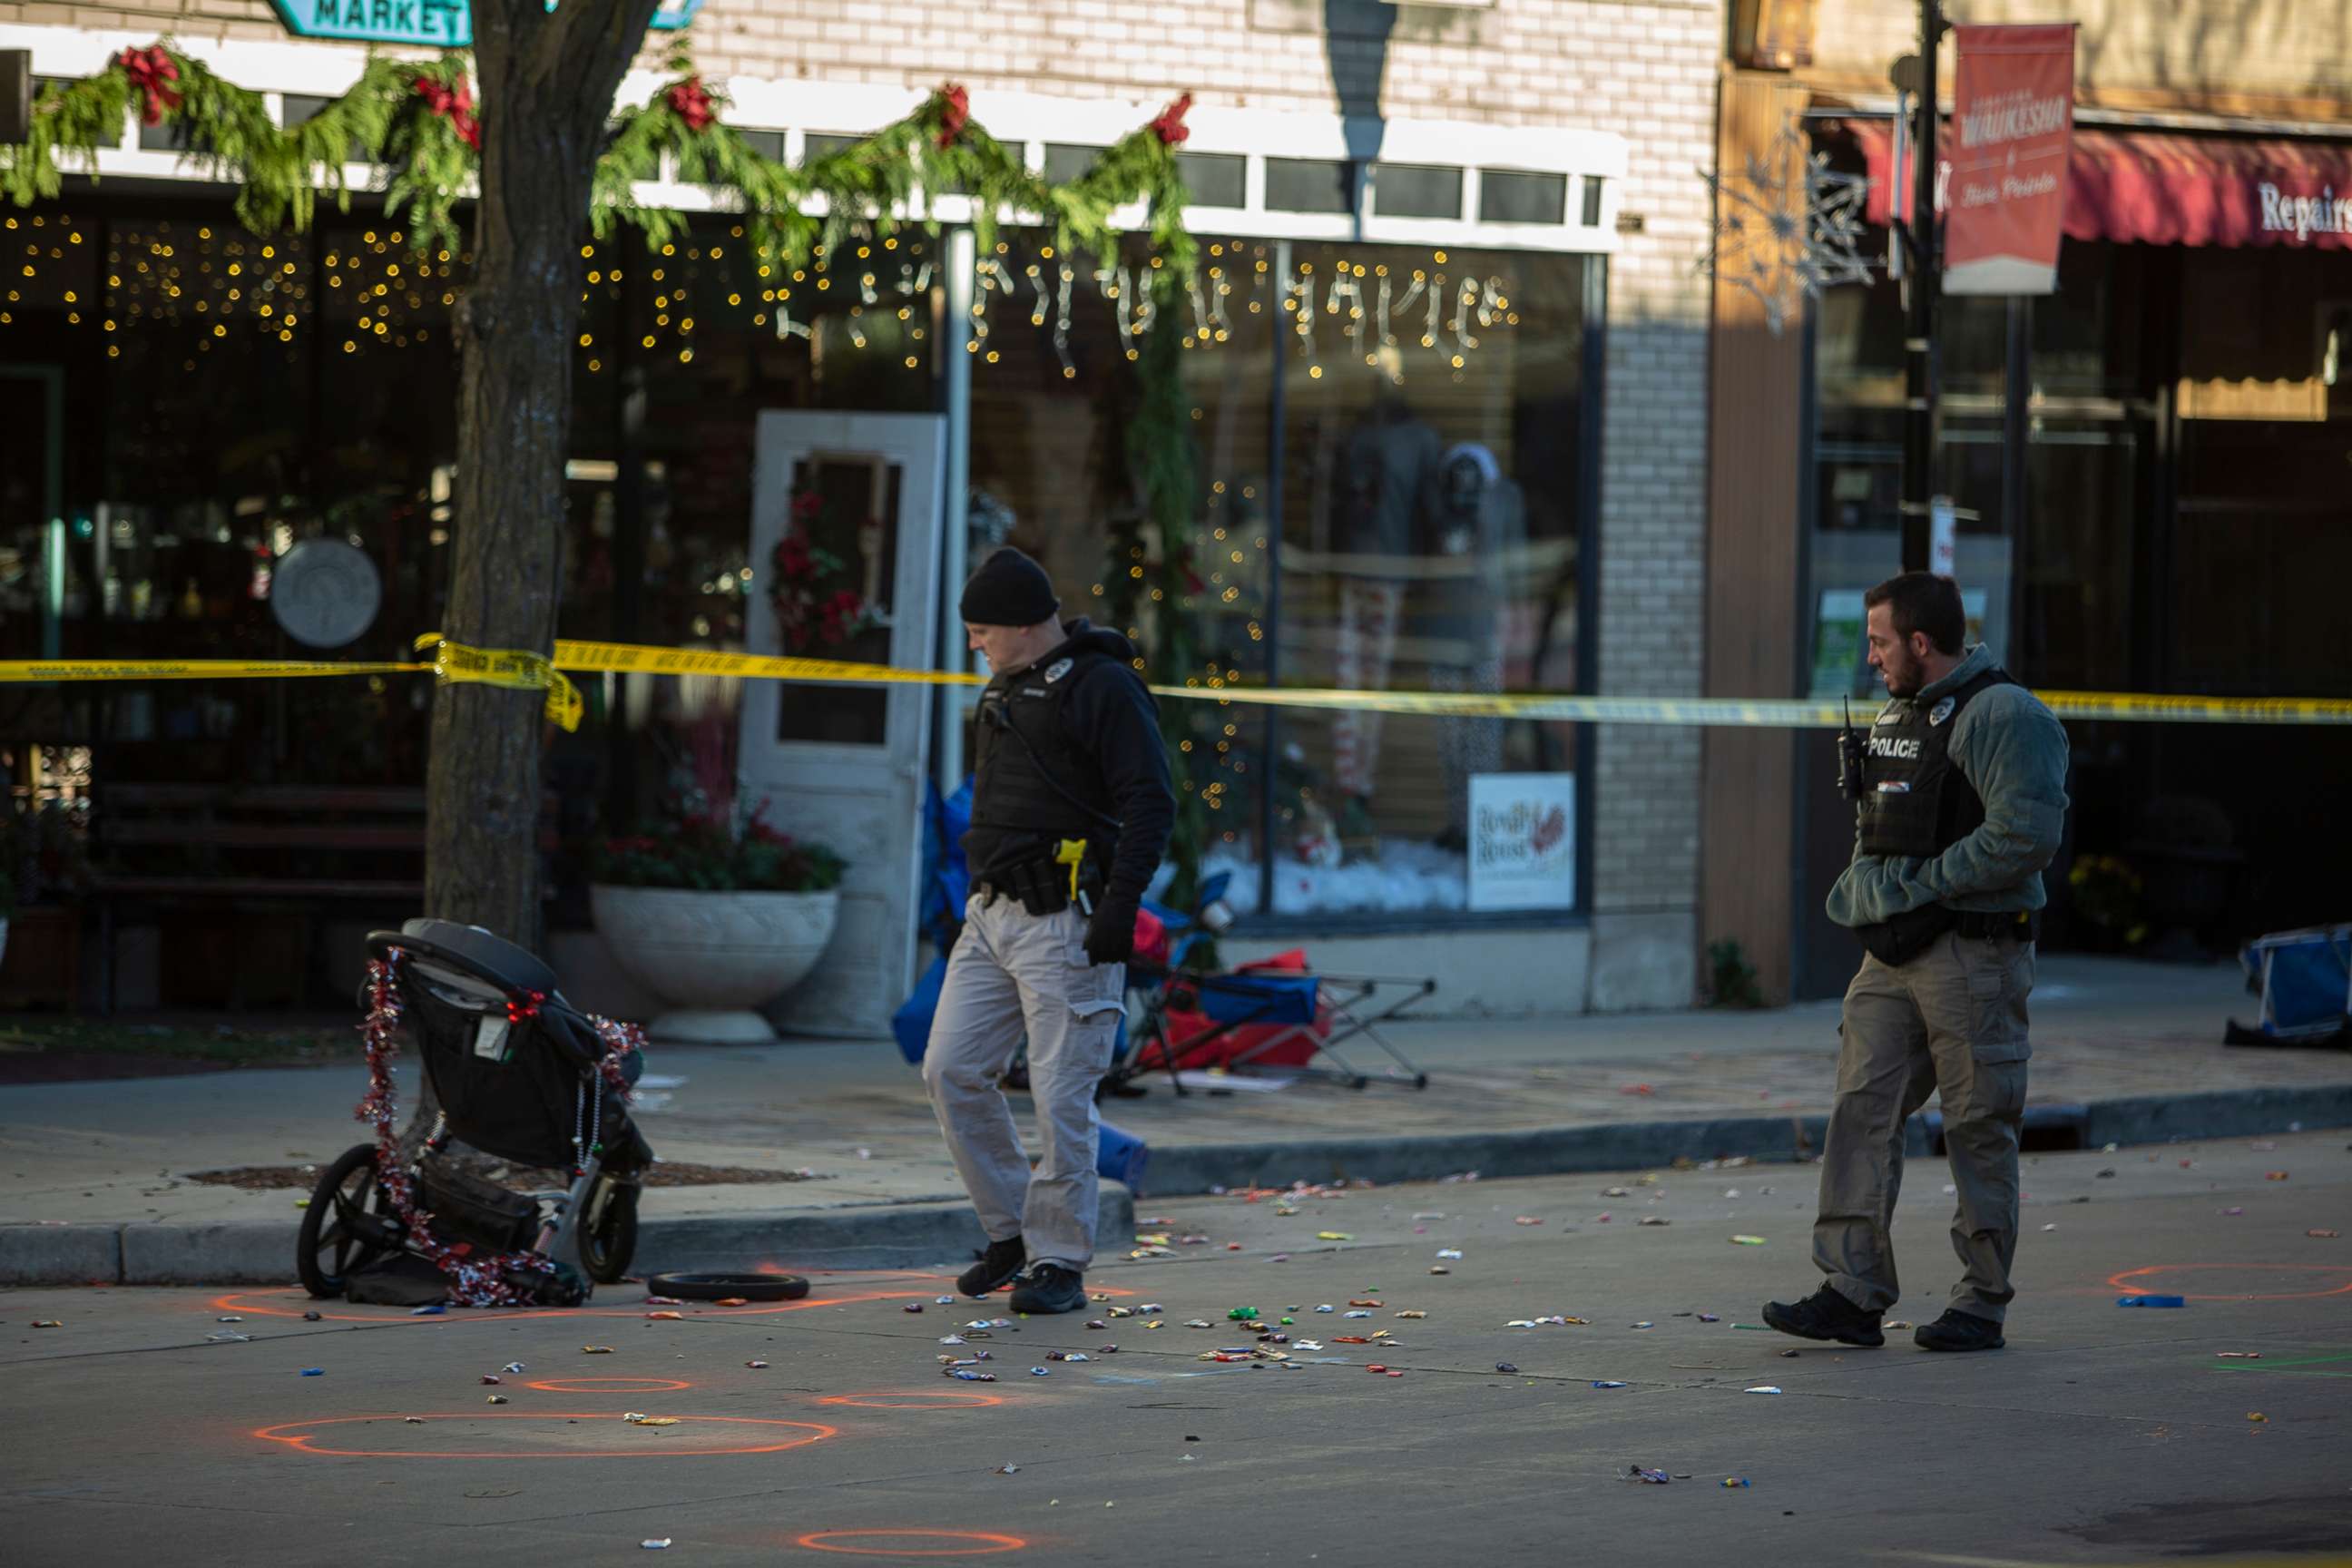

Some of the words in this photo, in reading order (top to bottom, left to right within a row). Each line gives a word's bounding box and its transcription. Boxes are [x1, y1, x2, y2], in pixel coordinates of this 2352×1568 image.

[313, 0, 470, 36] MARKET
[2257, 181, 2352, 241] Repairs
[1867, 737, 1920, 759] POLICE
